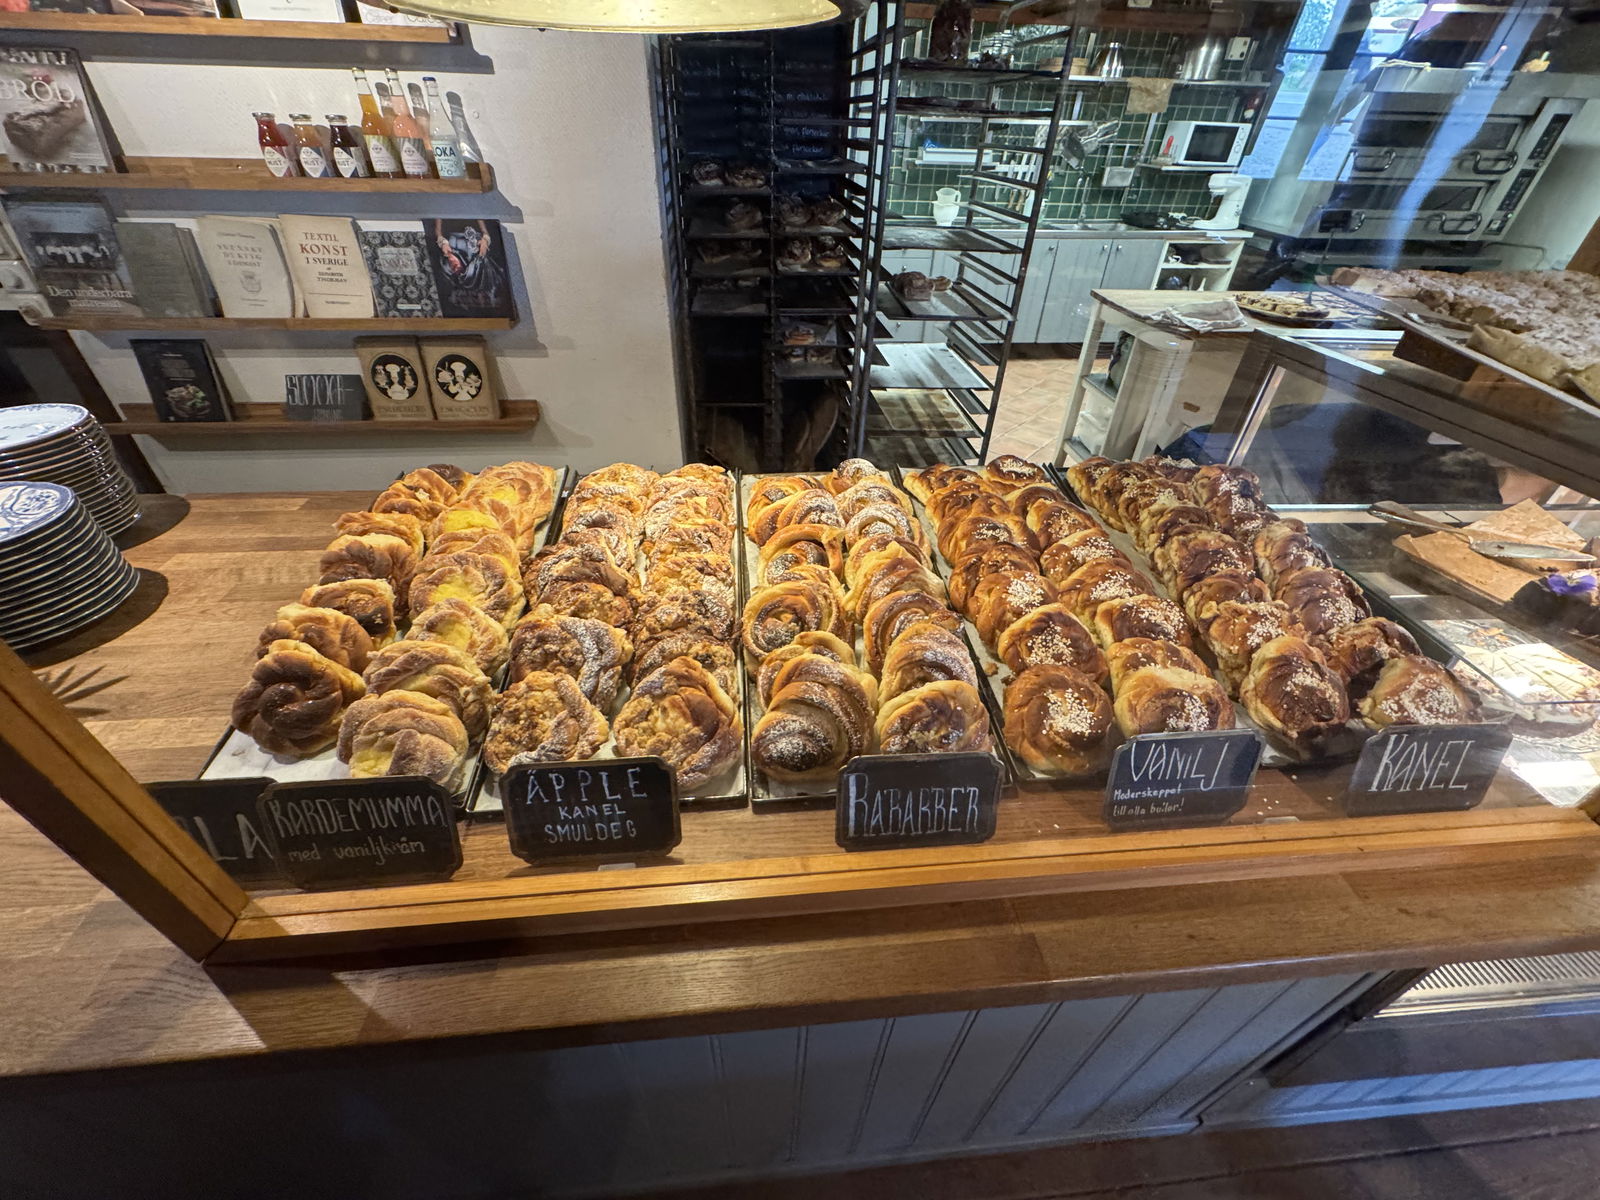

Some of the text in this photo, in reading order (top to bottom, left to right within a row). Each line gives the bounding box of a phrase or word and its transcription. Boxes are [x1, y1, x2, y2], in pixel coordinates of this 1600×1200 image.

[302, 231, 340, 242] TEXTIL
[299, 243, 348, 256] KONST
[313, 257, 350, 266] SVERIGE
[1130, 740, 1231, 791] VANILJ
[1368, 734, 1475, 792] KANEL
[526, 767, 648, 805] ÄPPLE
[267, 795, 448, 838] KARDEMUMMA
[558, 803, 627, 820] KANEL
[844, 773, 979, 837] RABARBER
[544, 820, 637, 844] SMULDEG
[288, 843, 322, 862] med
